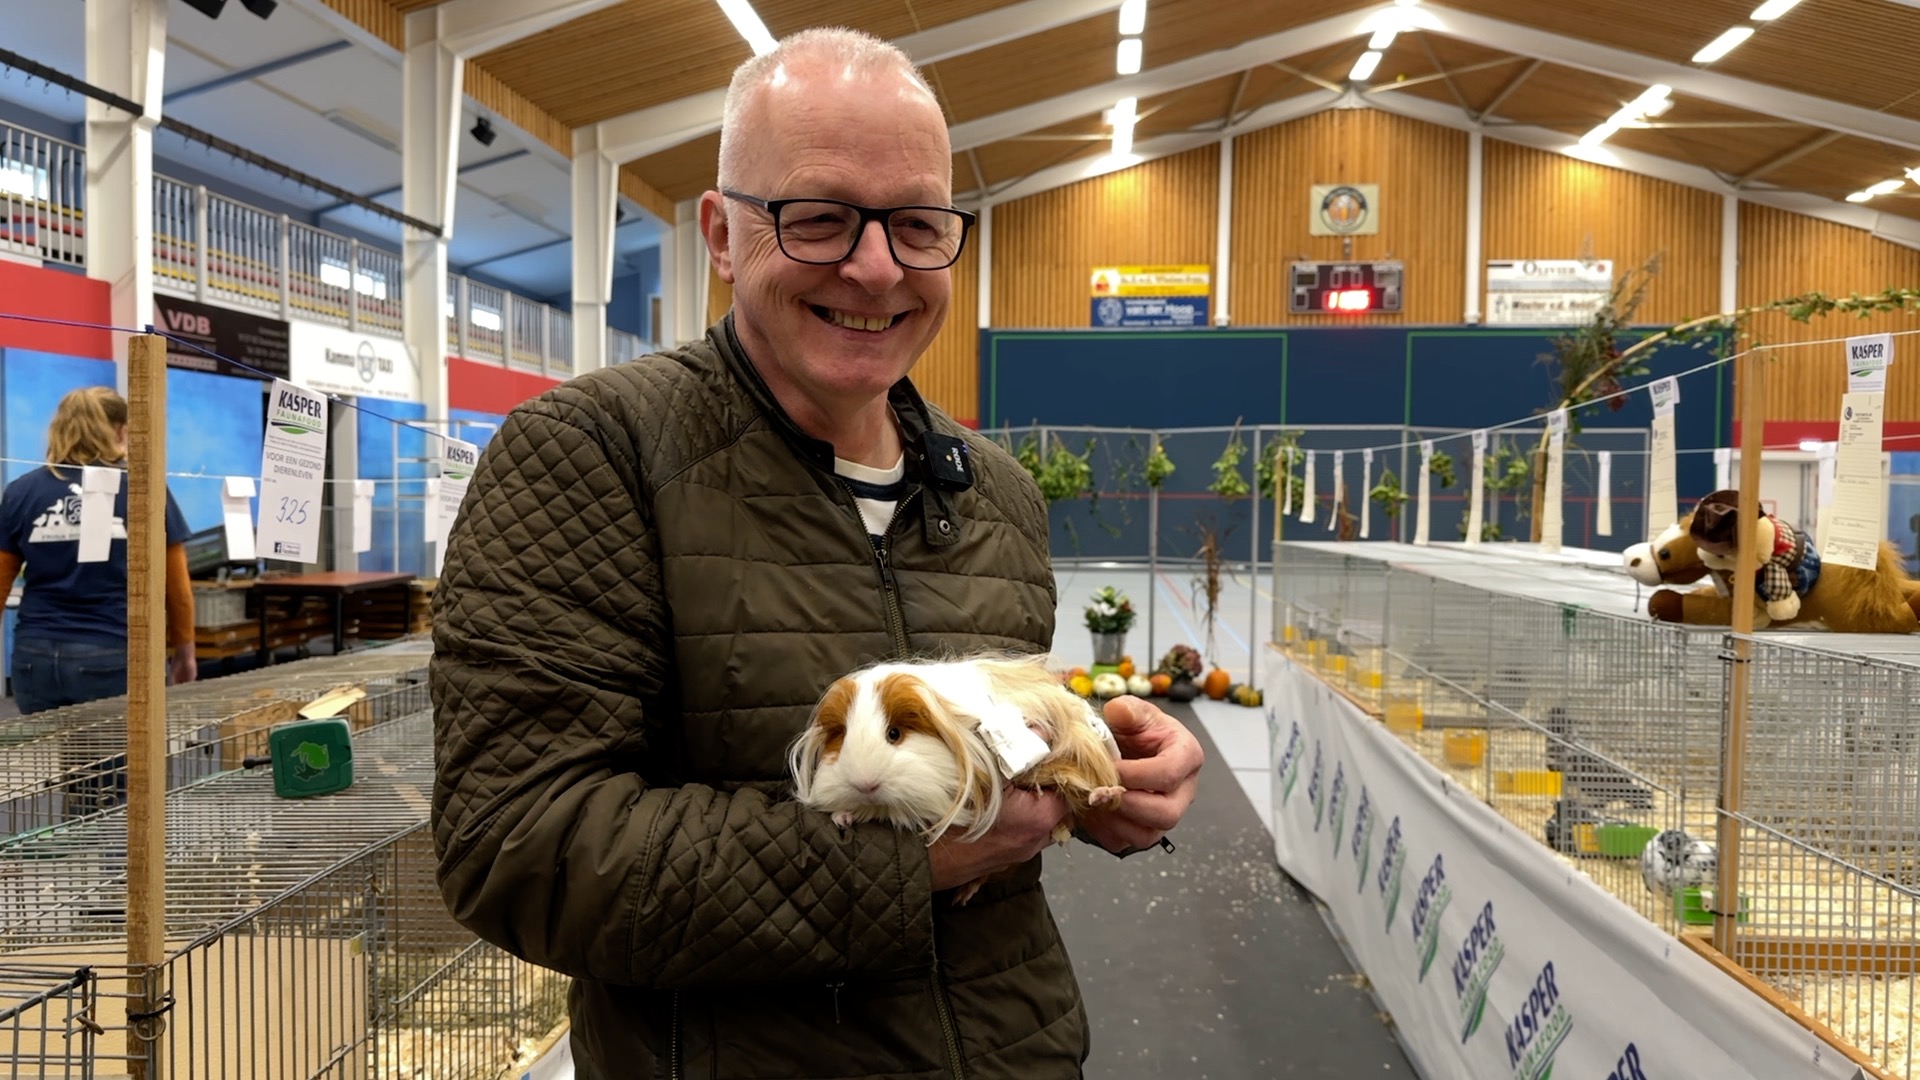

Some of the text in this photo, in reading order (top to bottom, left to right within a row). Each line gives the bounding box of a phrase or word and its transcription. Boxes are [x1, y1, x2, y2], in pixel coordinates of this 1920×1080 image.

[166, 309, 211, 335] VDB
[1852, 343, 1884, 360] KASPER
[278, 390, 322, 418] KASPER
[276, 409, 322, 428] FAUNAFOOD
[265, 451, 322, 471] VOOR EEN GEZOND
[447, 446, 475, 465] KASPER
[273, 465, 313, 480] DIERENLEVEN
[276, 496, 311, 525] 325
[1452, 900, 1495, 999] KASPER
[1505, 960, 1559, 1070] KASPER
[1514, 1004, 1566, 1080] AUNAFOOD
